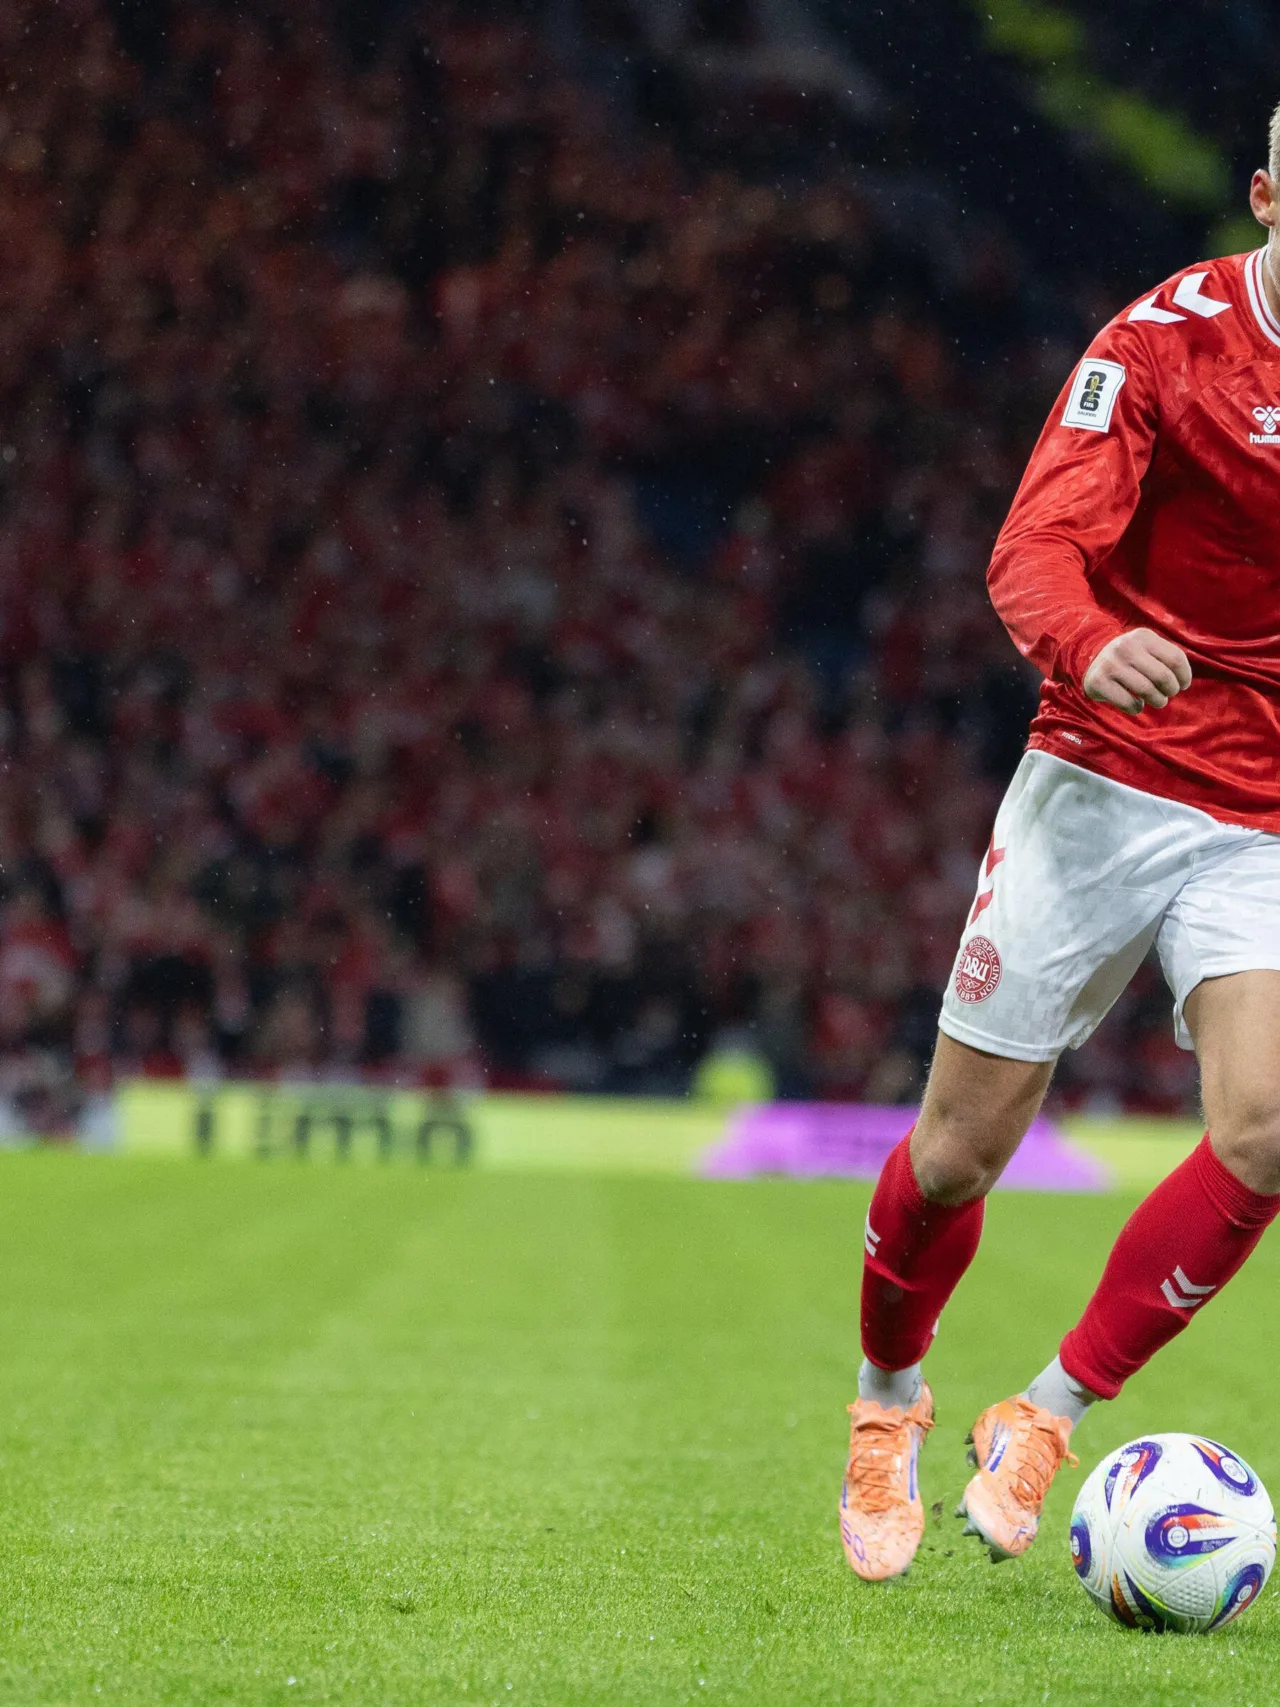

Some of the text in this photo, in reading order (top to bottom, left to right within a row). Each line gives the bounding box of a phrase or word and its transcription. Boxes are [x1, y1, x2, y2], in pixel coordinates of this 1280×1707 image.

[962, 955, 989, 982] DBU
[979, 965, 1000, 998] UNION
[957, 988, 976, 1001] 1889
